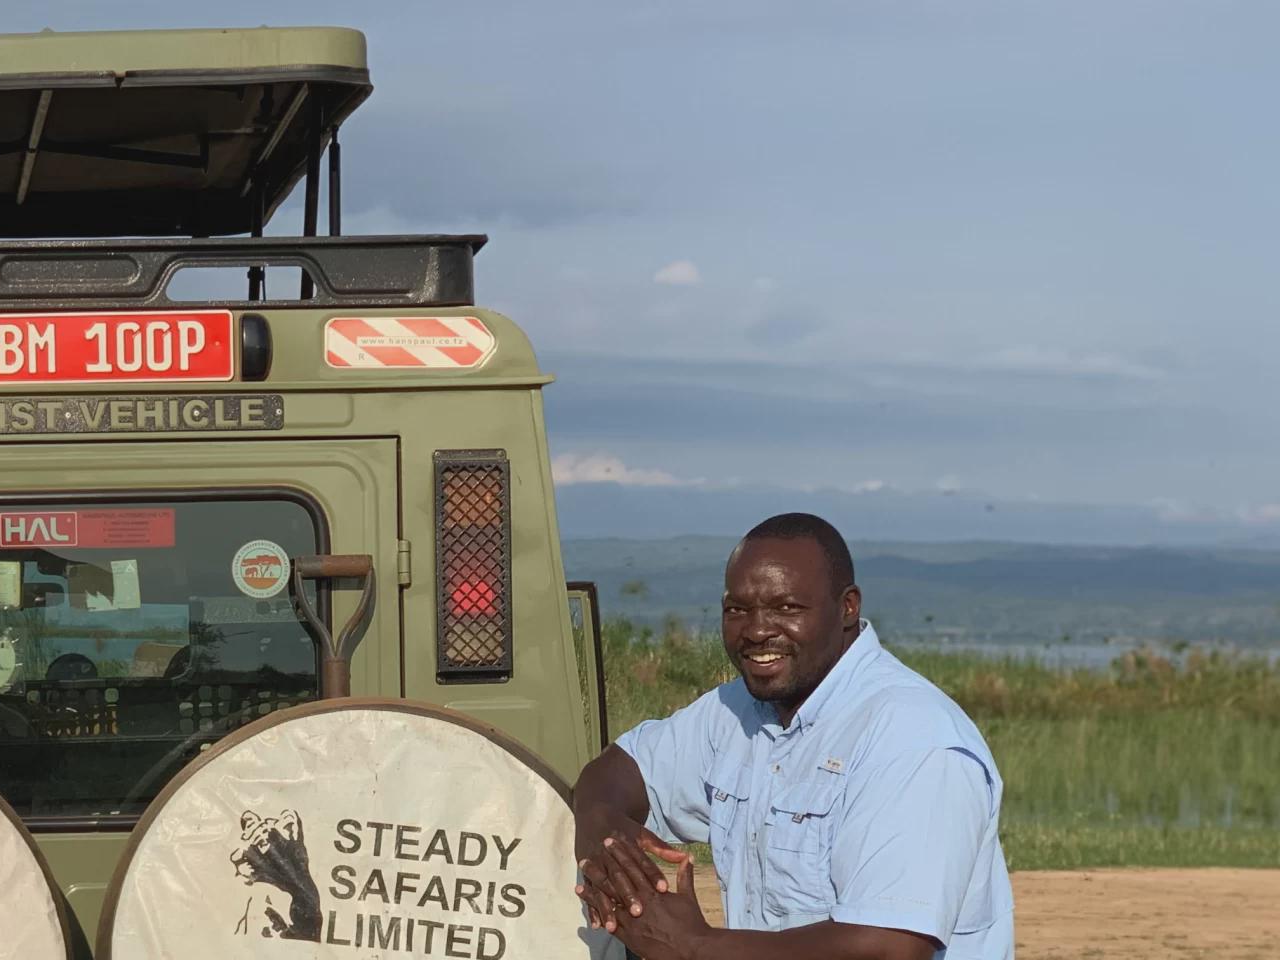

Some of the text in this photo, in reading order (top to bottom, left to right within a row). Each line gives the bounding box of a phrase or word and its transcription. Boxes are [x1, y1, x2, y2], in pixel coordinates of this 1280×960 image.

[84, 320, 206, 373] 100P
[78, 398, 265, 430] VEHICLE
[4, 516, 70, 542] HAL
[333, 819, 522, 871] STEADY
[328, 865, 527, 918] SAFARIS
